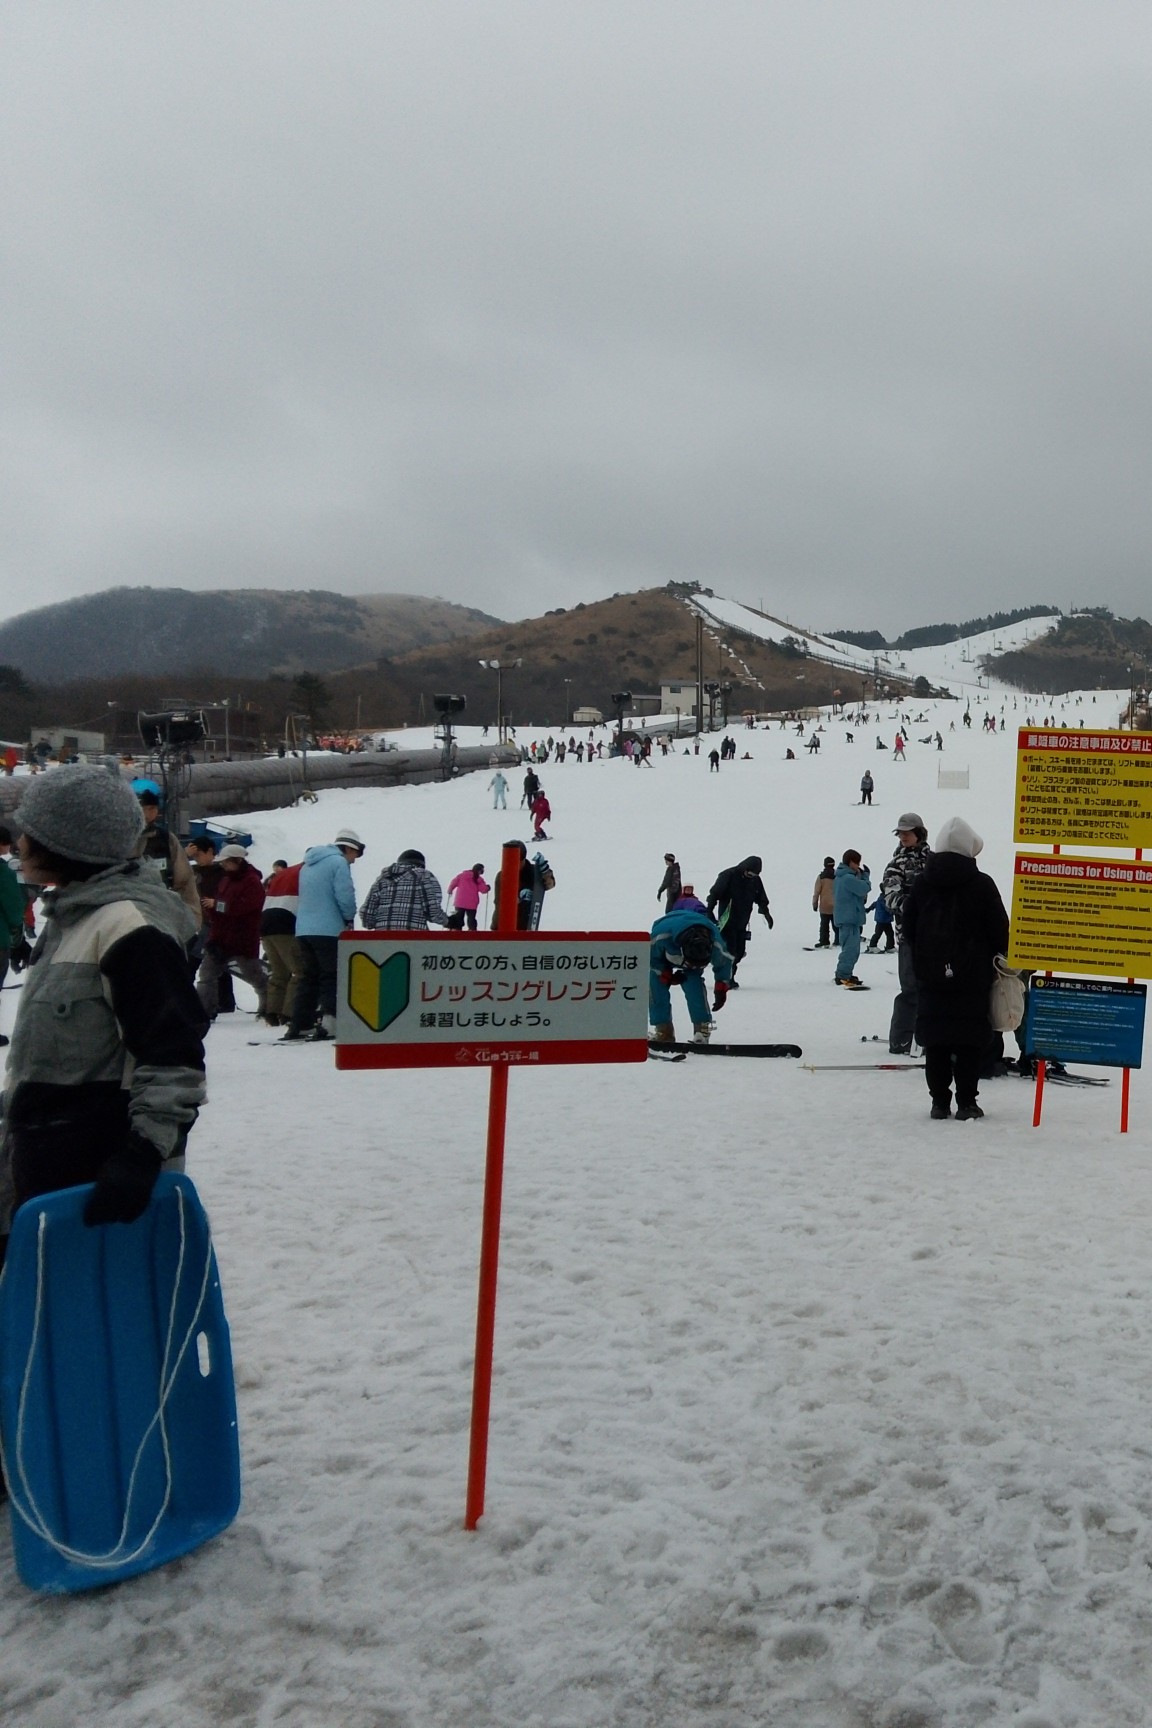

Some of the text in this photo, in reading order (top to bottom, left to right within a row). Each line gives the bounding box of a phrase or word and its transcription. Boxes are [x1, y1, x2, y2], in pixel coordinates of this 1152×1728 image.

[1020, 860, 1084, 876] Precautions
[1085, 865, 1101, 877] for
[1102, 866, 1134, 881] Using
[1134, 869, 1152, 881] the
[421, 955, 638, 971] 初めての方、自信のない方は
[420, 980, 637, 1002] レッスンゲレンデで
[420, 1012, 551, 1028] 練習しましょう。
[475, 1051, 539, 1062] くじゅうスキー場
